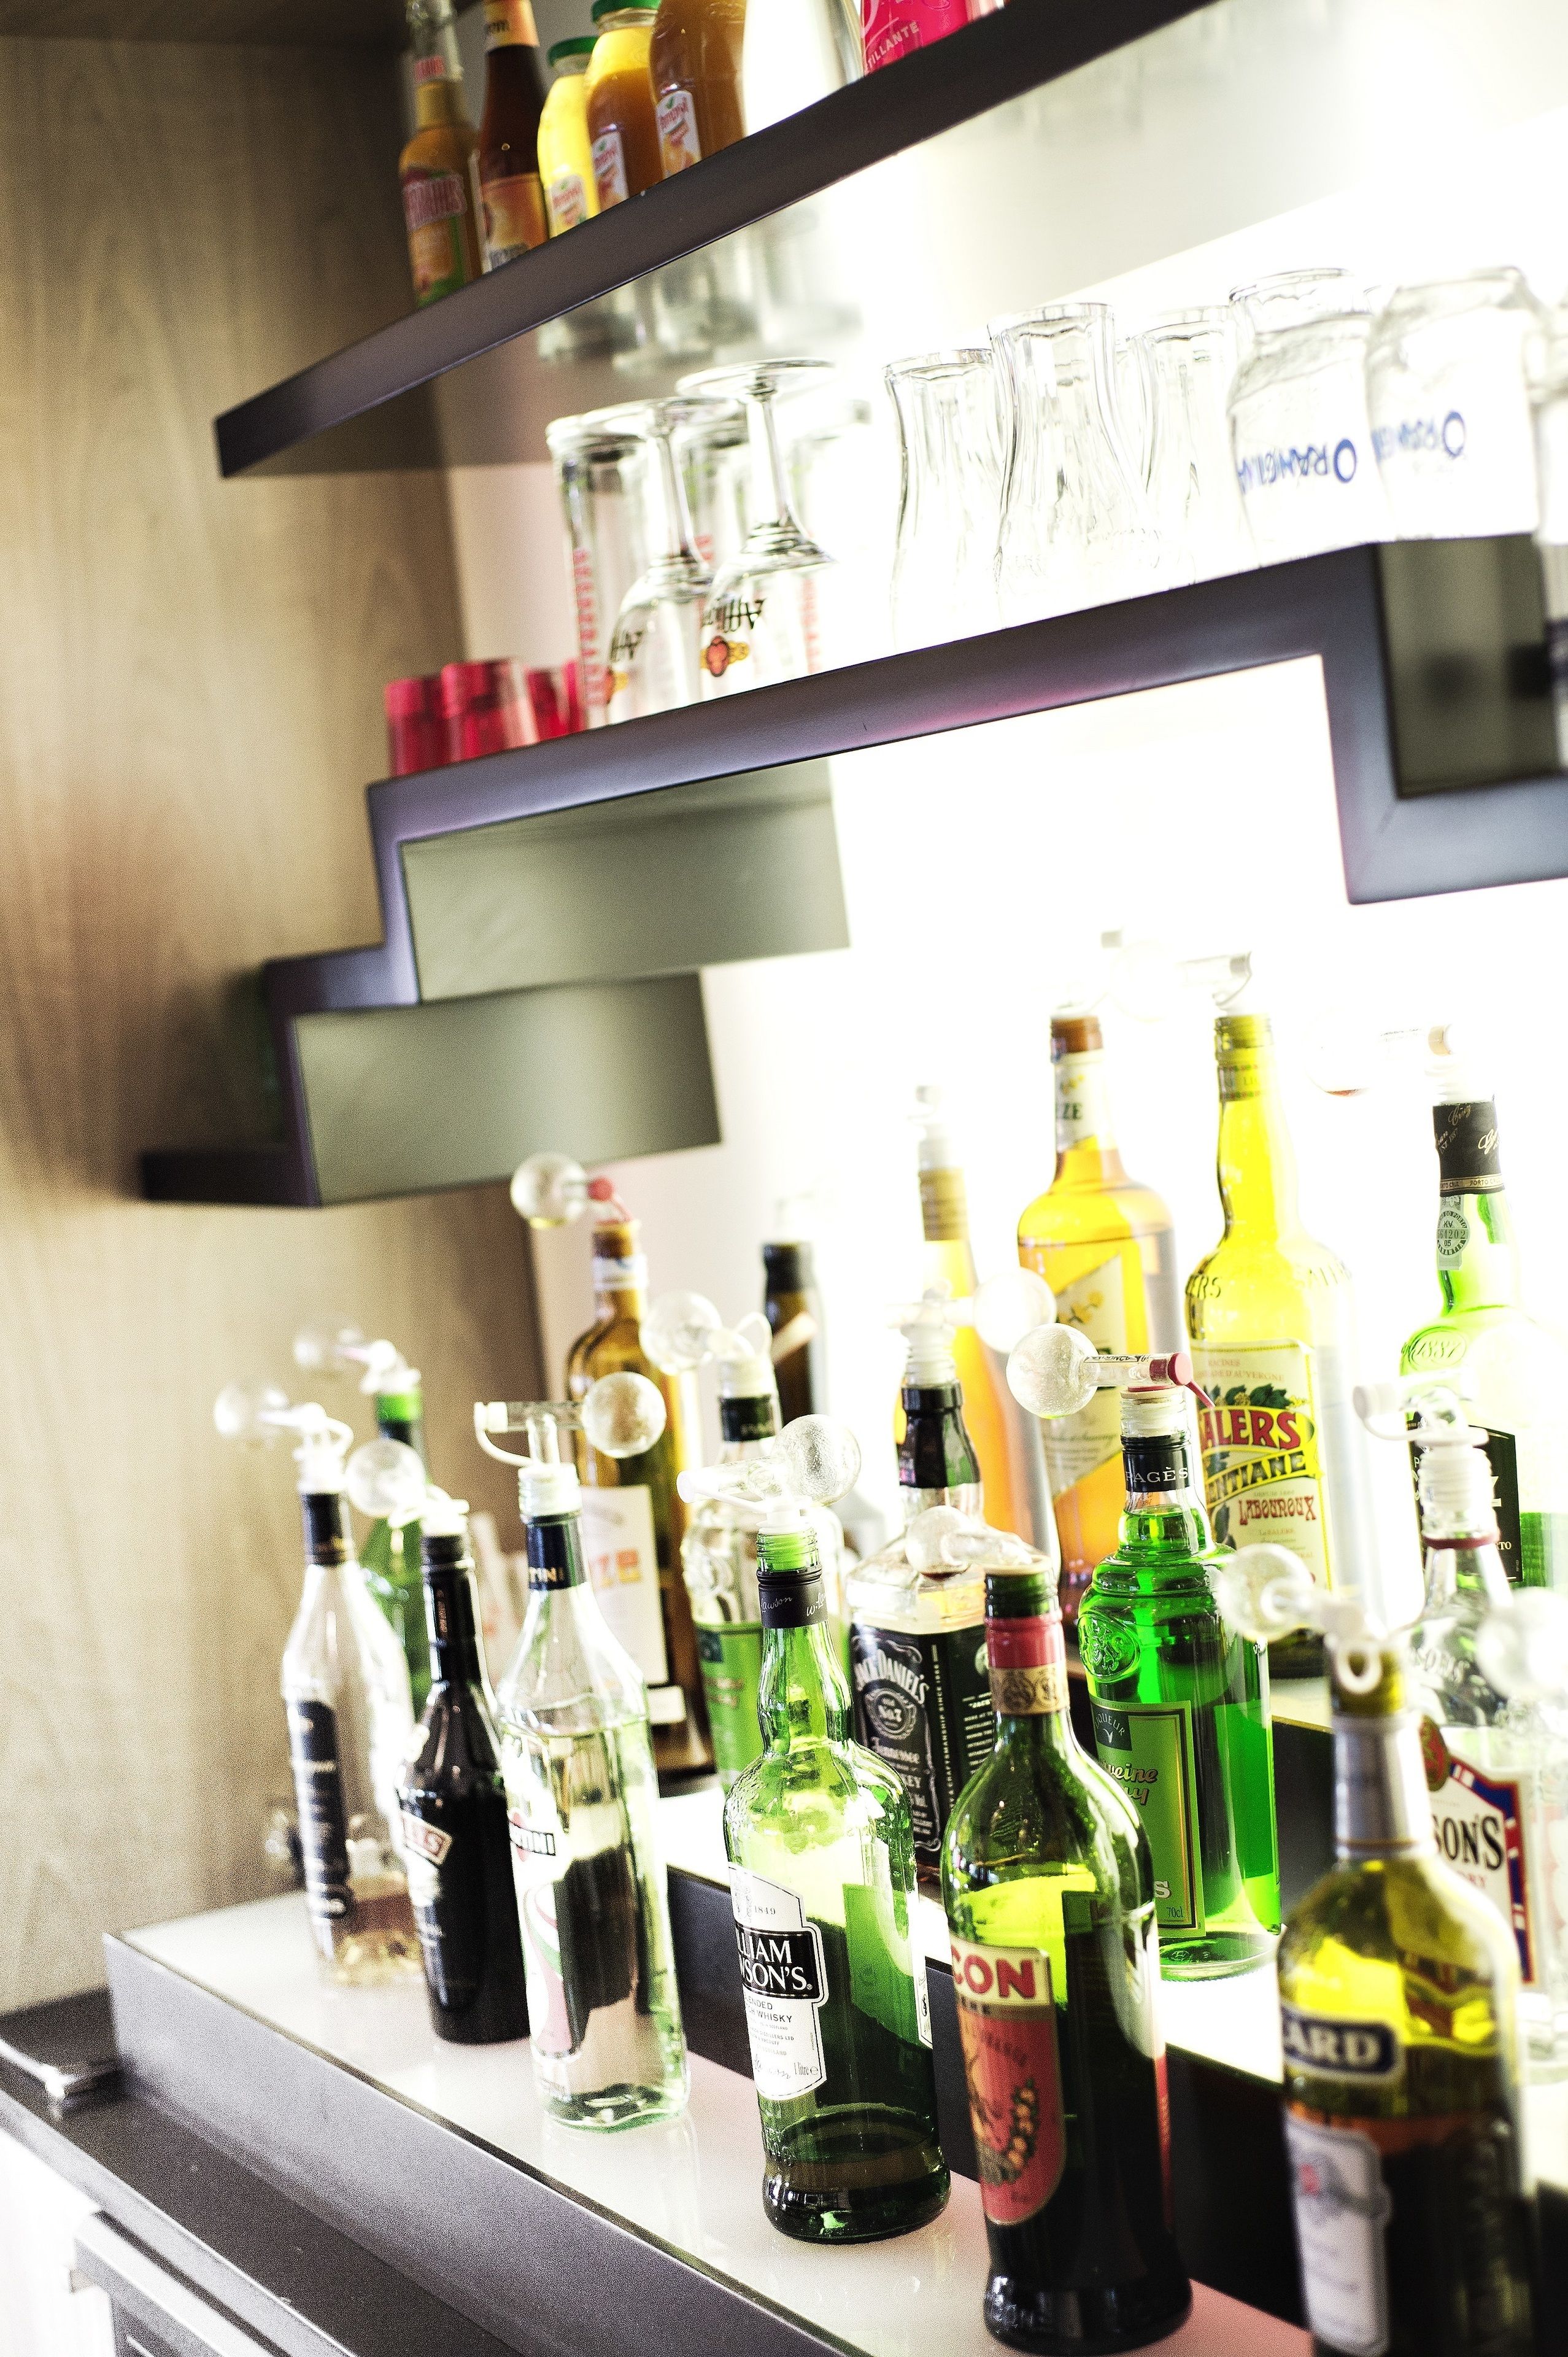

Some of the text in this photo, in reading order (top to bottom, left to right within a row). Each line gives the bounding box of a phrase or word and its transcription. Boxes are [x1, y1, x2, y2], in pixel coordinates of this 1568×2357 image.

[1201, 1409, 1301, 1453] ALERS
[1208, 1450, 1307, 1504] ENTIANE
[757, 2010, 793, 2024] WHISKY
